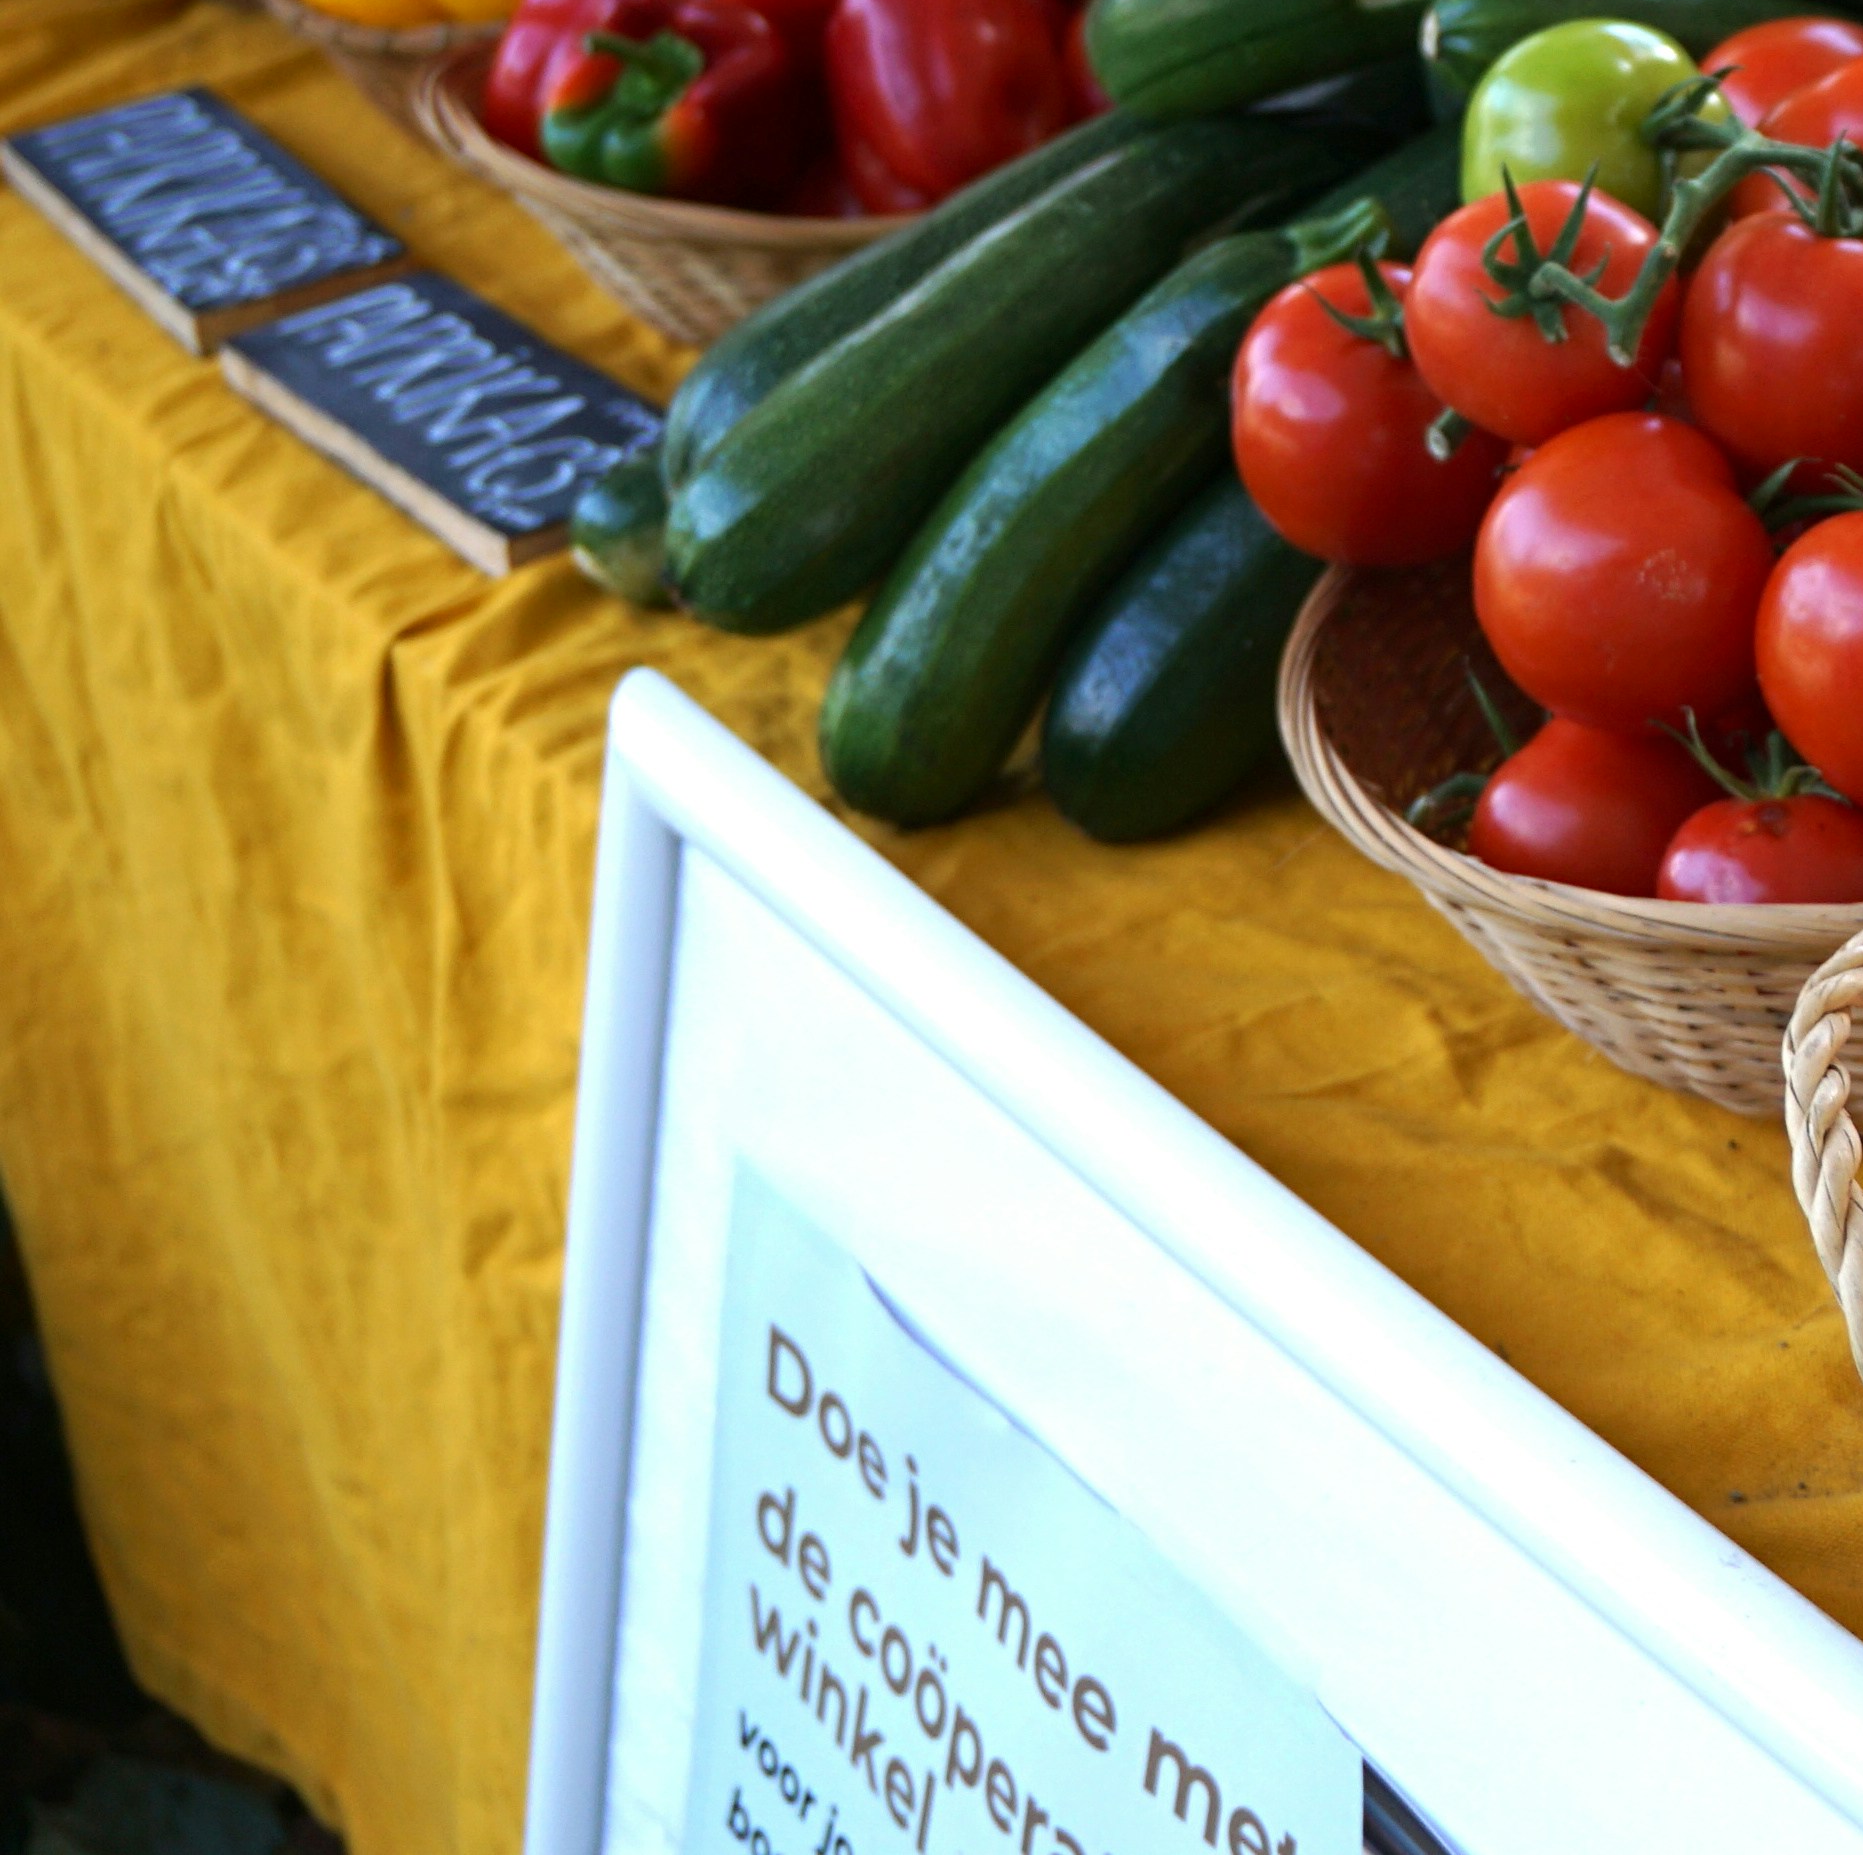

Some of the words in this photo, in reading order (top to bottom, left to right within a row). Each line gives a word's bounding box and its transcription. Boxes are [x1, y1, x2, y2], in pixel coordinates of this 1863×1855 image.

[755, 1485, 832, 1603] de
[765, 1322, 888, 1502] Doe
[900, 1453, 960, 1578] je
[975, 1553, 1118, 1754] mee
[738, 1707, 818, 1822] voor
[748, 1582, 938, 1854] winkel
